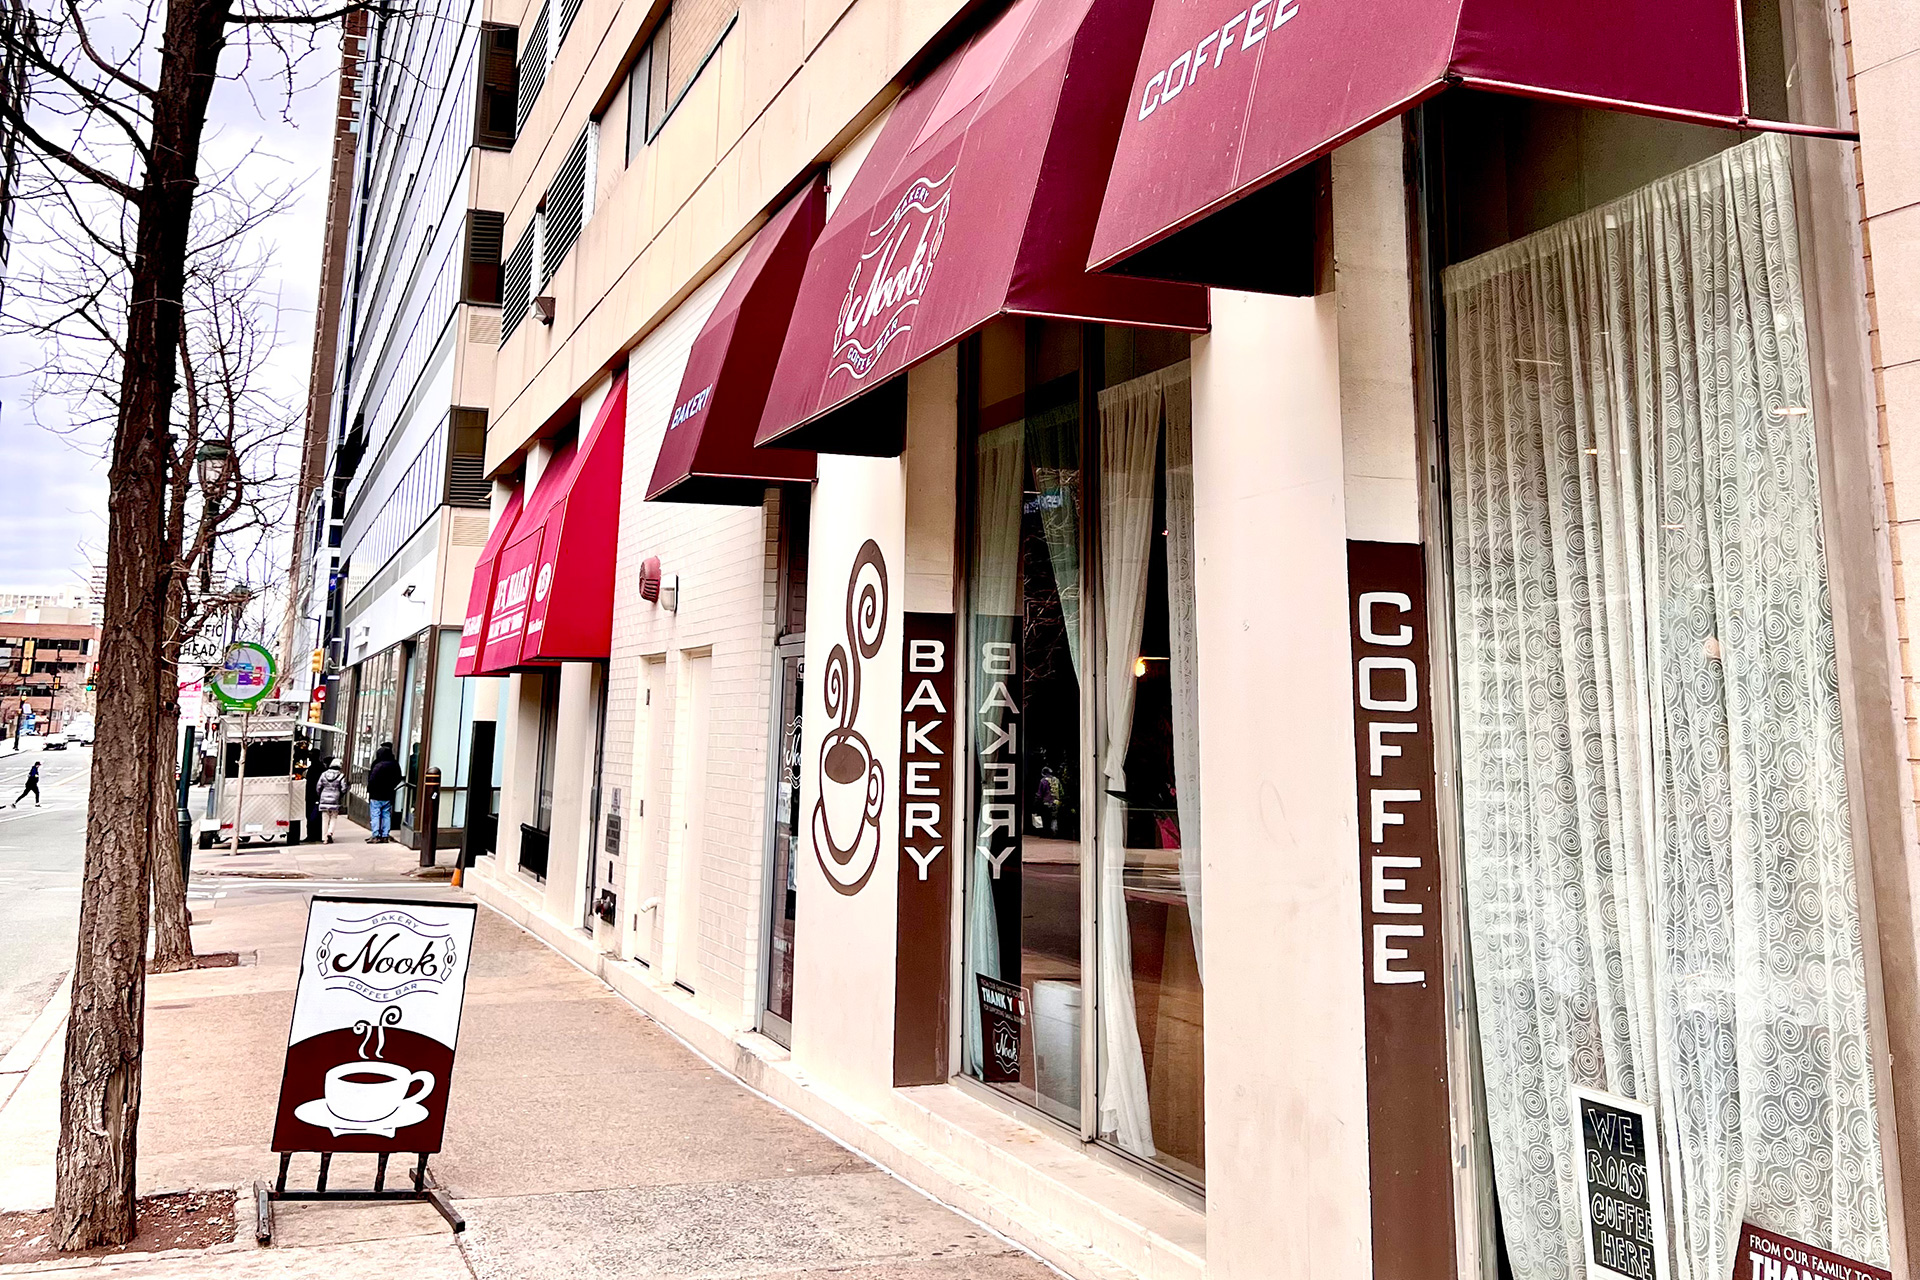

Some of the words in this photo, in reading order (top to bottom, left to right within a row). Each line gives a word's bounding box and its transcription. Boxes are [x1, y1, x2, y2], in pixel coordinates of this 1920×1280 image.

[1138, 0, 1301, 122] COFFEE
[893, 186, 930, 224] BAKERY
[843, 214, 934, 337] Nook
[847, 346, 873, 371] COFFEE
[876, 317, 899, 355] BAR
[670, 383, 713, 430] BAKERY
[904, 639, 947, 881] BAKERY
[1358, 591, 1425, 984] COFFEE
[371, 915, 419, 929] BAKERY
[332, 932, 438, 977] Nook
[348, 980, 389, 999] COFFEE
[395, 983, 418, 996] BAR
[981, 986, 1007, 1010] THANK
[1587, 1108, 1636, 1158] WE
[1586, 1148, 1651, 1204] ROAST
[1591, 1192, 1655, 1246] COFFEE
[1600, 1230, 1654, 1280] HERE
[1749, 1234, 1781, 1258] FROM
[1783, 1247, 1809, 1268] OUR
[1811, 1255, 1852, 1280] FAMILY
